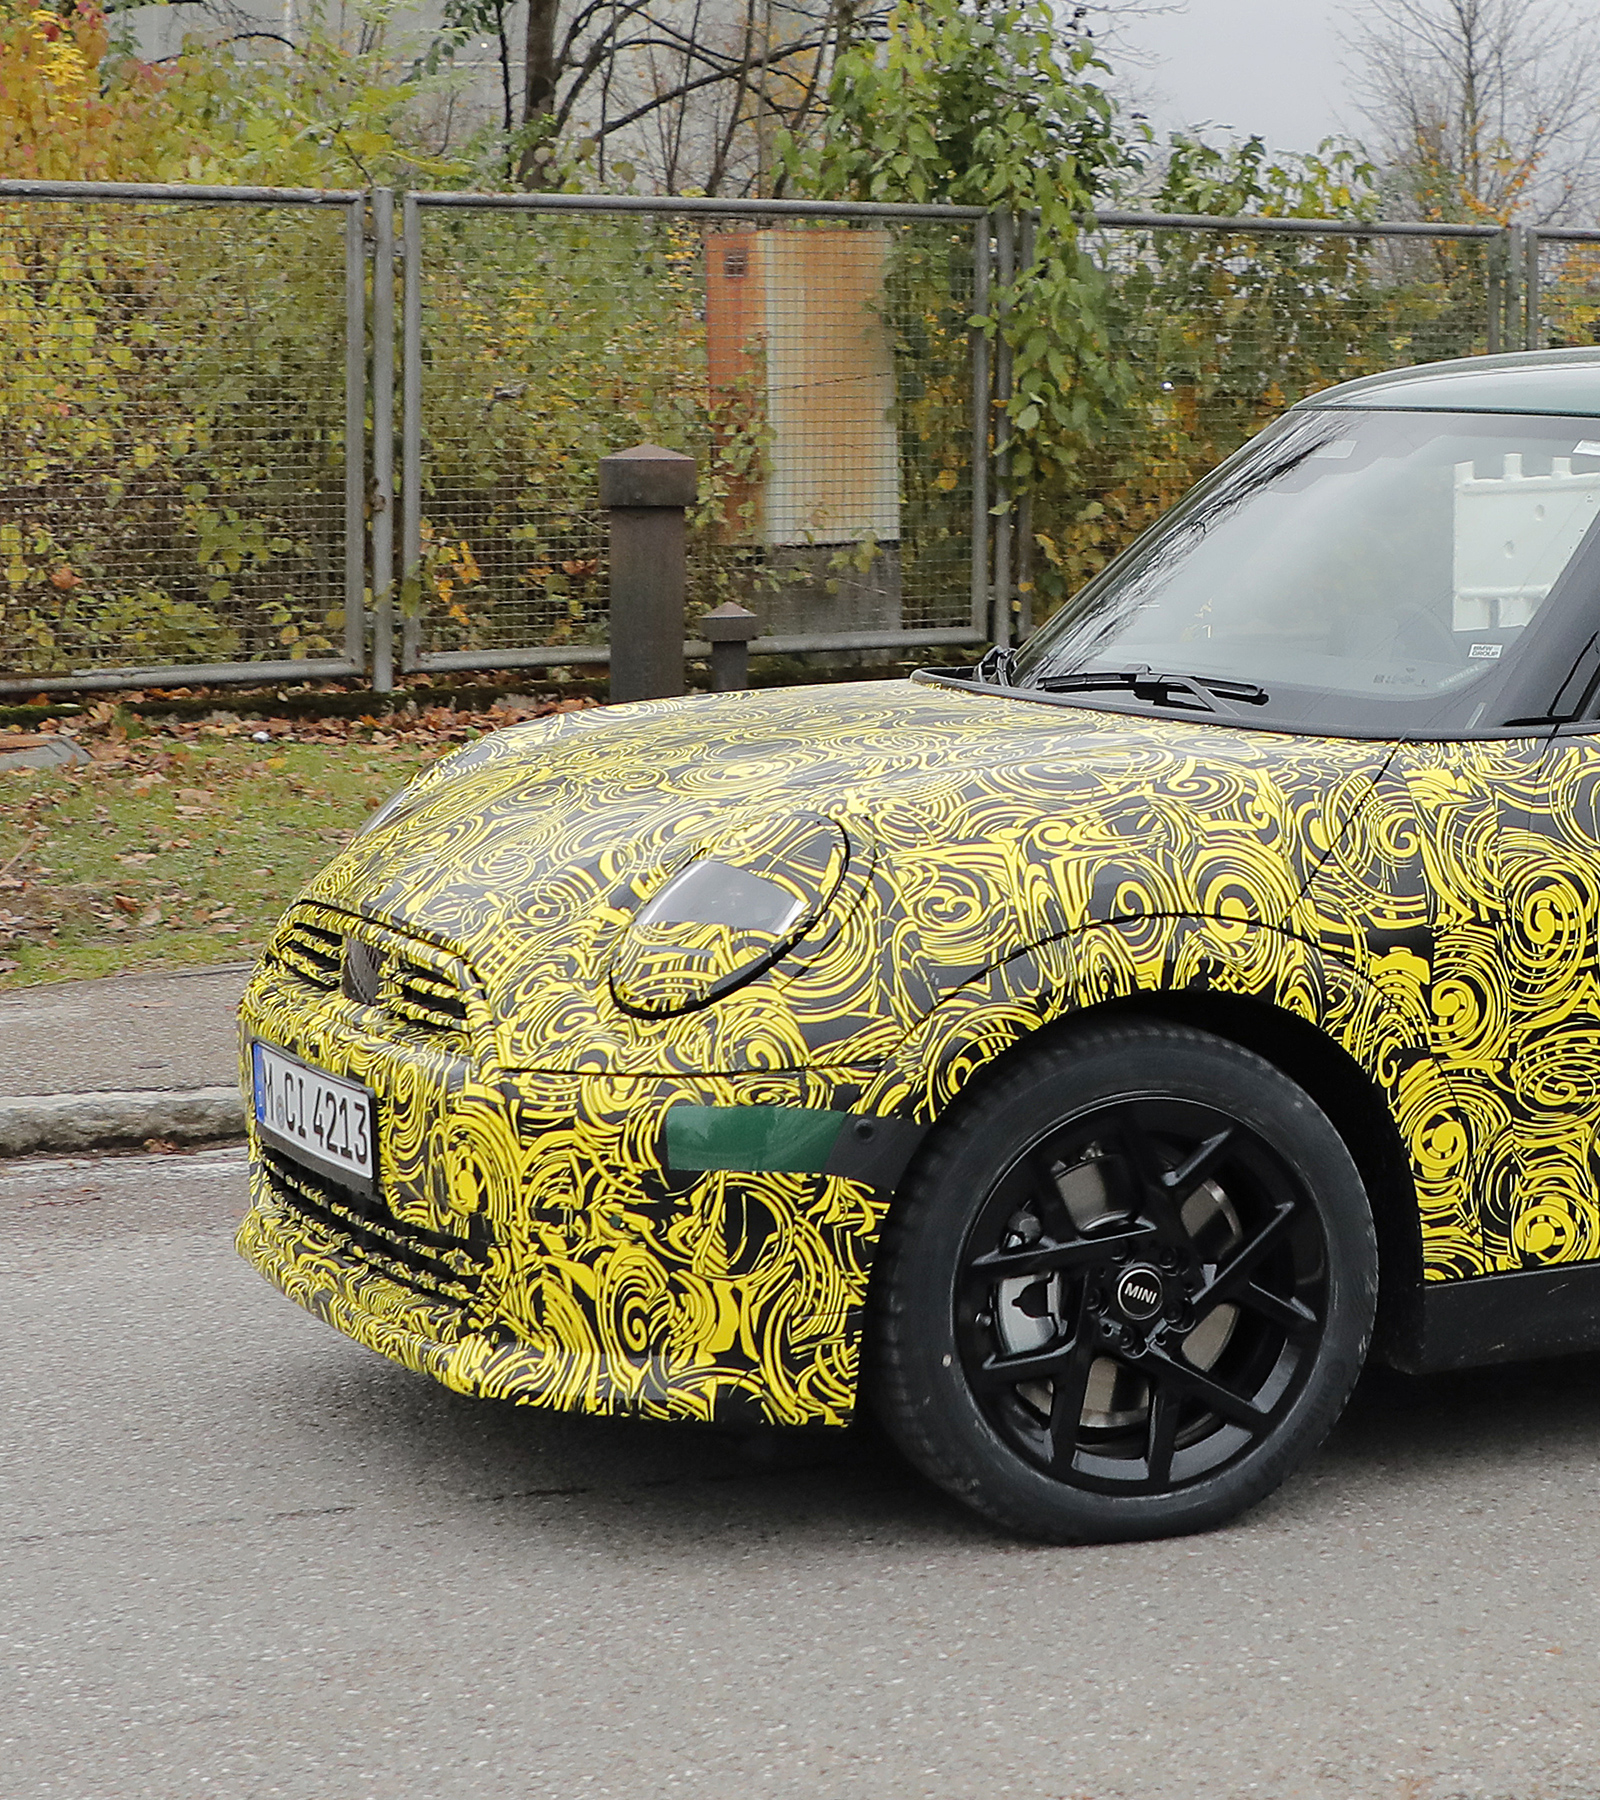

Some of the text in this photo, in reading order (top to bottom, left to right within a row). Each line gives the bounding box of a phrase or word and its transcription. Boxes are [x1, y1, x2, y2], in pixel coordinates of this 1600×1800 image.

[285, 1071, 307, 1139] CI
[313, 1086, 367, 1165] 4213
[1124, 1282, 1158, 1305] MINI
